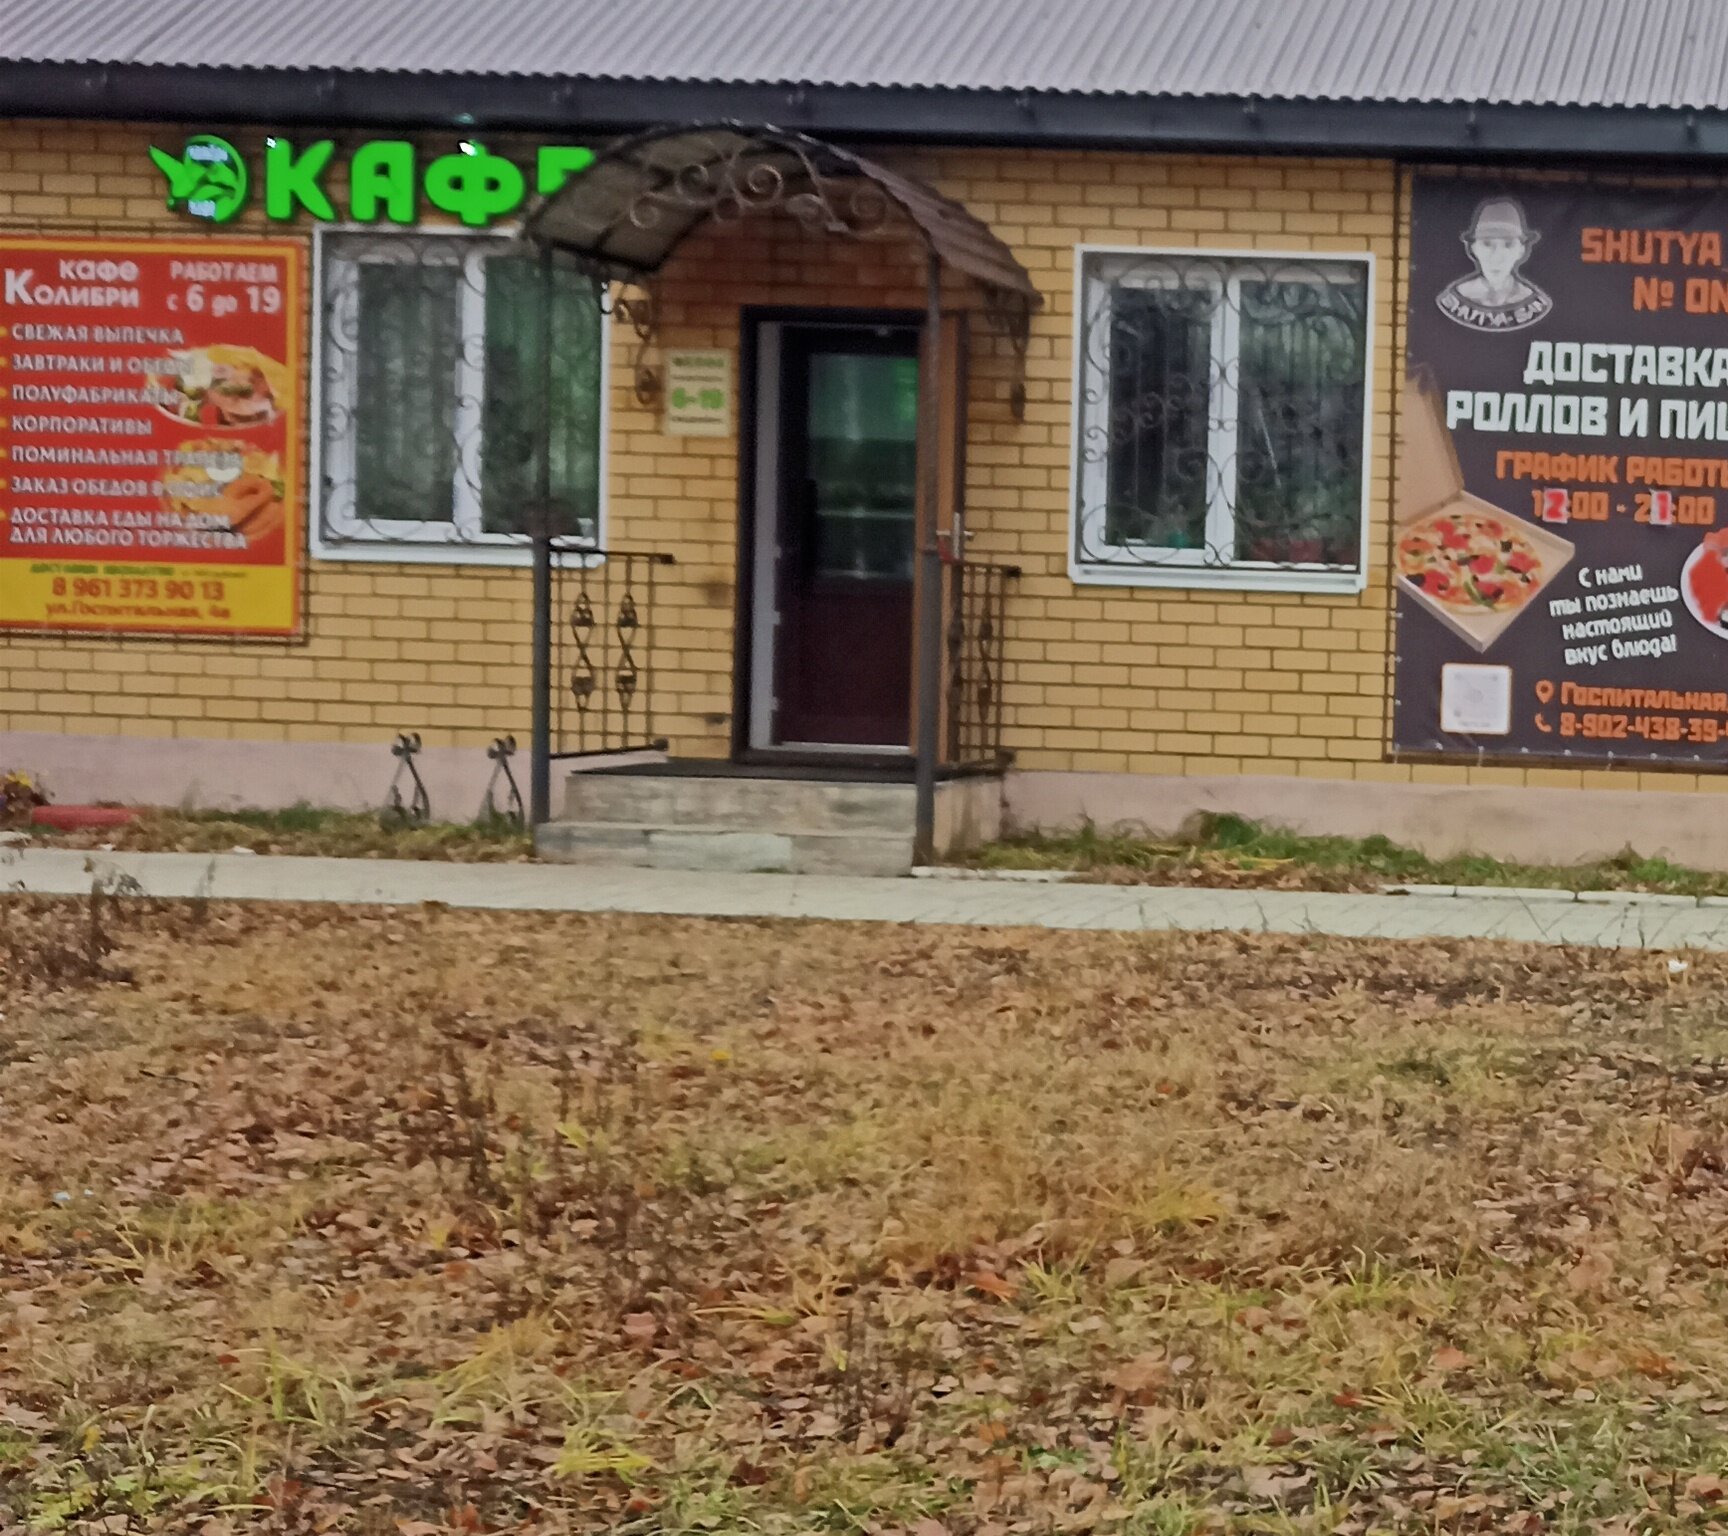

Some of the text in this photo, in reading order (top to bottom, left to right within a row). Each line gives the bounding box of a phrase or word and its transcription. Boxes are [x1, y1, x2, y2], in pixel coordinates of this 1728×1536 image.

[168, 260, 278, 283] РАБОТАЕМ
[186, 284, 205, 312] 6
[245, 285, 282, 314] 19
[12, 323, 184, 344] СВЕЖАЯ ВЫПЕЧКА
[12, 353, 105, 373] ЗАВТРАКИ
[108, 357, 122, 372] И
[12, 384, 179, 405] ПОЛУФАБРИКАТЫ
[1446, 390, 1608, 436] РОЛЛОВ
[1619, 397, 1648, 437] И
[12, 416, 153, 435] КОРПОРАТИВЫ
[11, 445, 158, 465] ПОМИНАЛЬНАЯ
[1496, 450, 1618, 484] ГРАФИК
[11, 476, 68, 494] ЗАКАЗ
[72, 477, 148, 496] ОБЕДОВ
[11, 507, 108, 525] ДОСТАВКА
[156, 511, 182, 527] НА
[10, 527, 248, 549] ДЛЯ ЛЮБОГО ТОРЖЕСТВА
[1578, 564, 1643, 588] С нами
[52, 576, 225, 601] 8 961 373 90 13
[1549, 585, 1679, 617] ты познаешь
[1562, 608, 1673, 640] настоящий
[1564, 633, 1677, 665] вкус блюда!
